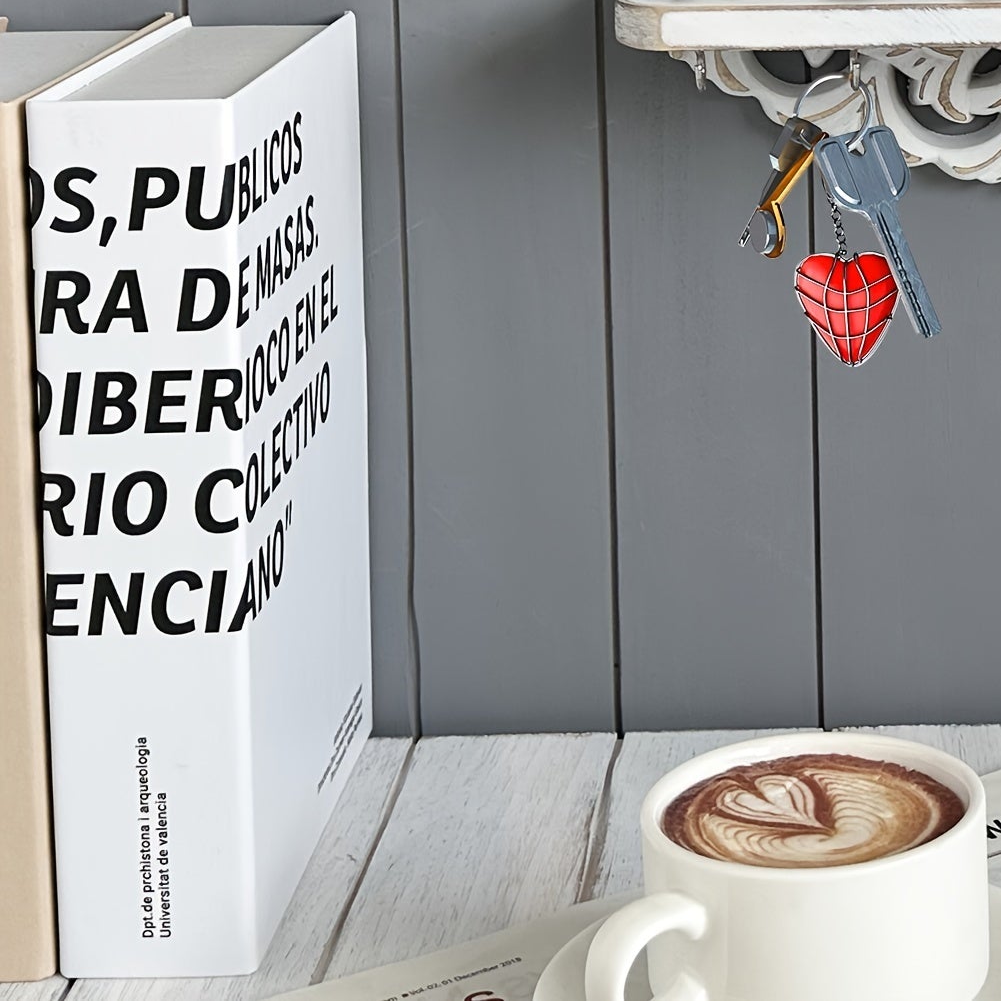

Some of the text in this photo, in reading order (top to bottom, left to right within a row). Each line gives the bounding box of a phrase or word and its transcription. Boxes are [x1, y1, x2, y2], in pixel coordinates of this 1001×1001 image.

[177, 256, 250, 331] DE
[255, 195, 318, 311] MASAS.
[295, 285, 315, 364] EN
[321, 264, 338, 334] EL
[195, 361, 330, 534] COLECTIVO
[155, 792, 172, 938] Universitat de valencia
[454, 965, 499, 982] December
